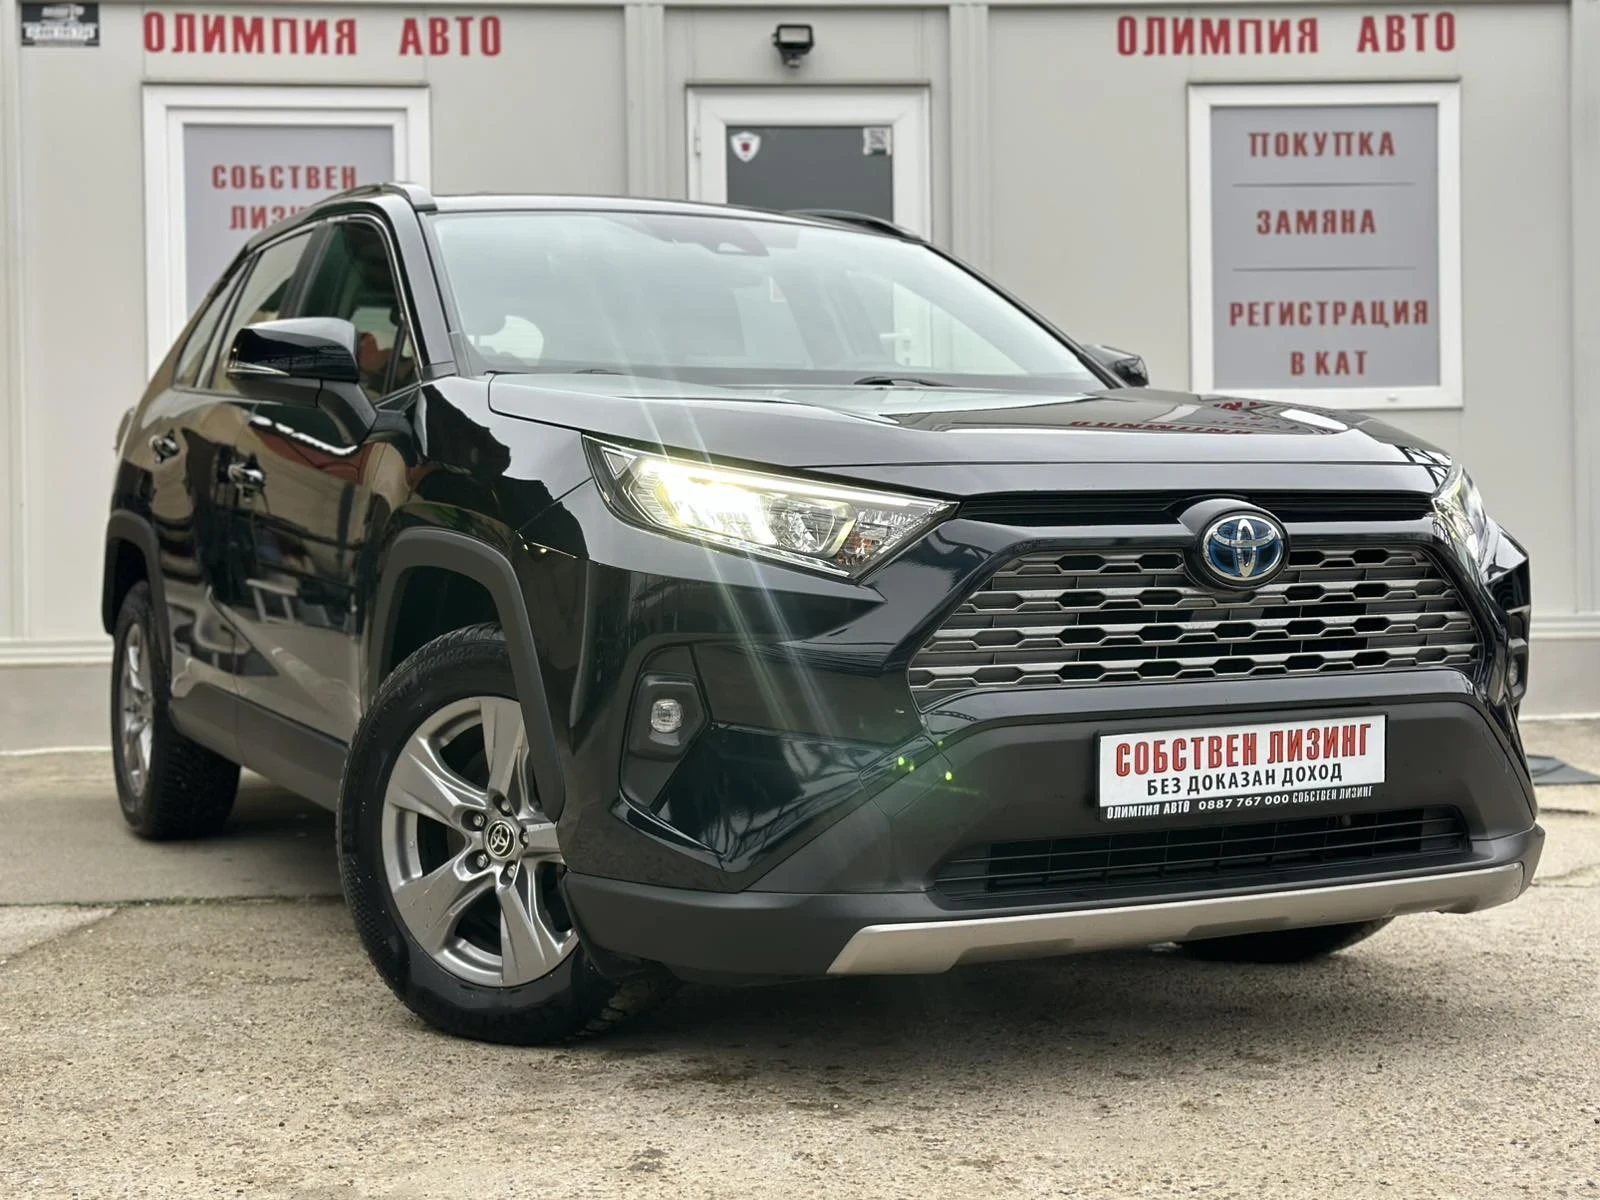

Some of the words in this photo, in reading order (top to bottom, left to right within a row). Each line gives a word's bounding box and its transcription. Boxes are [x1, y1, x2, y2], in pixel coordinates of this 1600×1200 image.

[143, 11, 359, 56] ОЛИМПИЯ
[399, 15, 503, 57] АВТО
[1117, 15, 1320, 57] ОЛИМПИЯ
[1357, 11, 1457, 55] АВТО
[1248, 131, 1396, 157] ПОКУПКА
[211, 164, 357, 190] СОБСТВЕН
[229, 204, 306, 230] ЛИЗ
[1256, 209, 1377, 236] ЗАМЯНА
[1229, 299, 1429, 328] РЕГИСТРАЦИЯ
[1289, 351, 1305, 377] В
[1315, 350, 1368, 376] КАТ
[1116, 732, 1258, 778] СОБСТВЕН
[1267, 723, 1372, 764] ЛИЗИНГ
[1147, 777, 1182, 796] БЕЗ
[1187, 769, 1276, 796] ДОКАЗАН
[1281, 763, 1343, 787] ДОХОД
[1107, 804, 1160, 819] ОЛИМПИЯ
[1163, 801, 1190, 814] АВТО
[1198, 799, 1233, 810] 0887
[1236, 796, 1261, 808] 767
[1264, 794, 1289, 805] 000
[1292, 789, 1337, 804] СОБСТВЕН
[1339, 785, 1374, 800] ЛИЗИНГ
